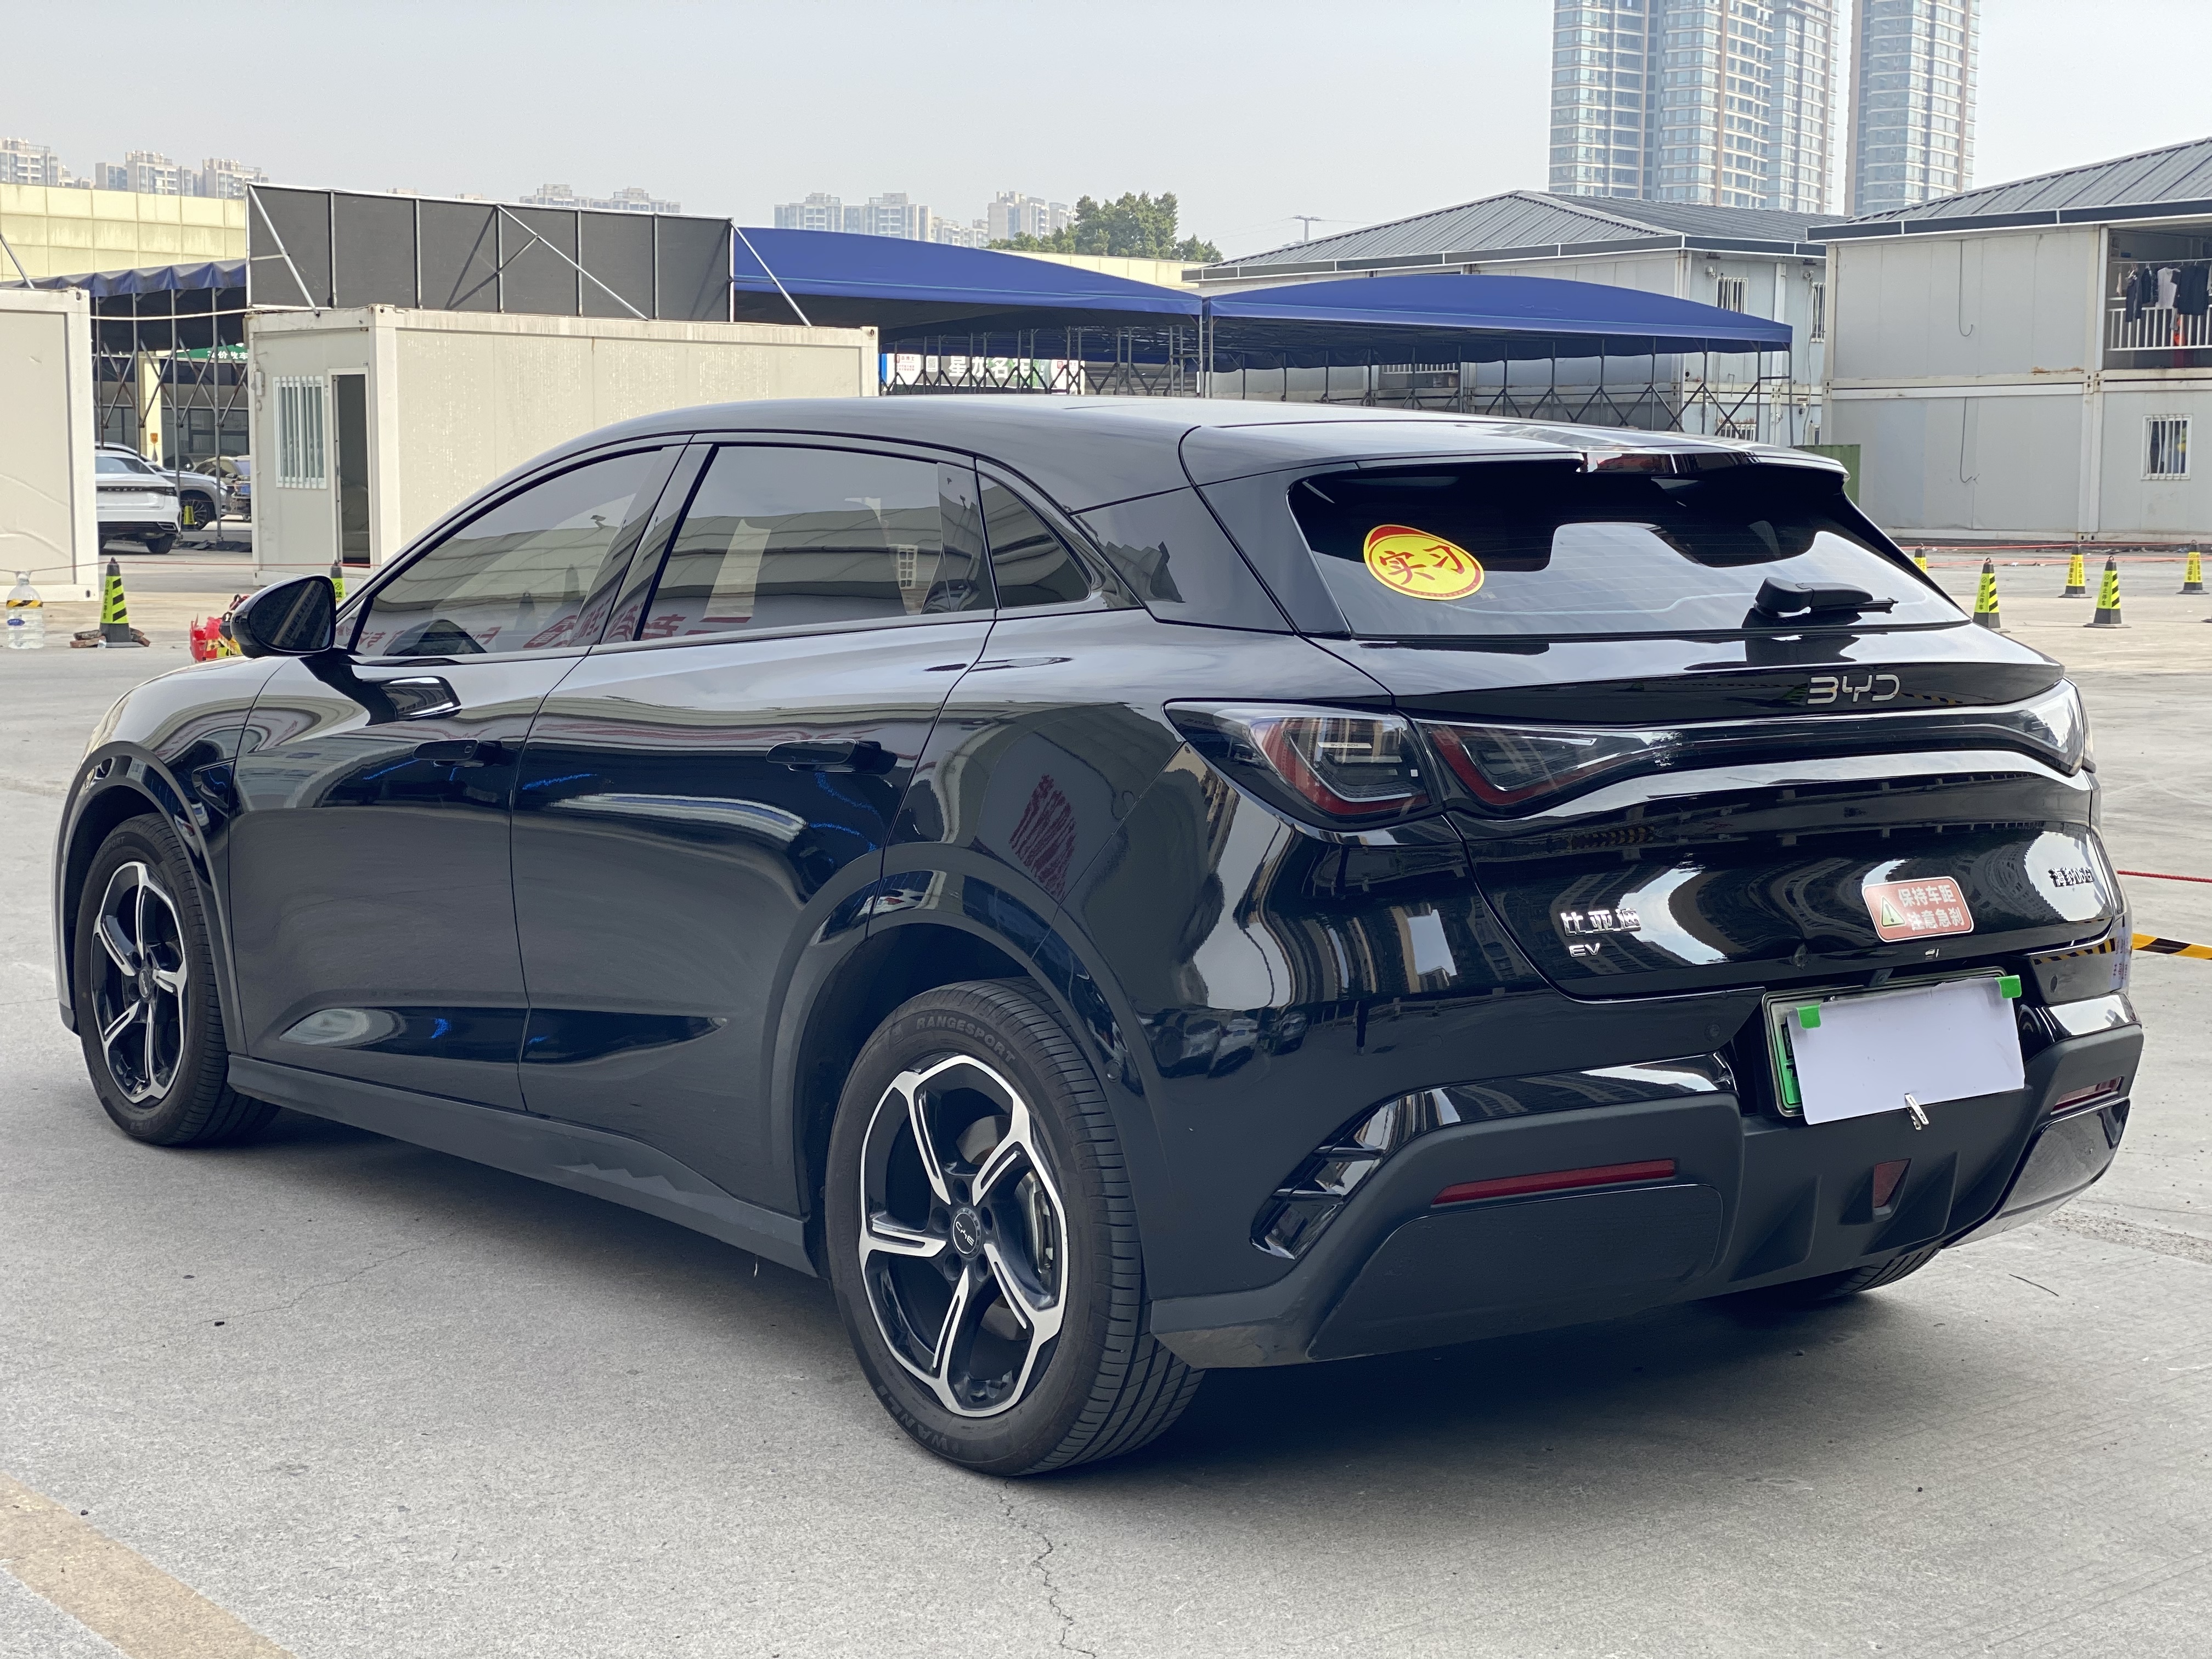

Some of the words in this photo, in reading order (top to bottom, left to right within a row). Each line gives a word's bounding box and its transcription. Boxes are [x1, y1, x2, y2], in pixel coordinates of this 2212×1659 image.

[1379, 545, 1465, 585] 实习
[1807, 674, 1901, 704] BYD
[1898, 884, 1956, 907] 保持车距
[1560, 908, 1641, 936] 比亚迪
[1906, 906, 1965, 932] 注意急刹
[1568, 943, 1600, 957] EV
[916, 1015, 1017, 1063] RANGESPORT
[955, 1221, 975, 1246] BYD
